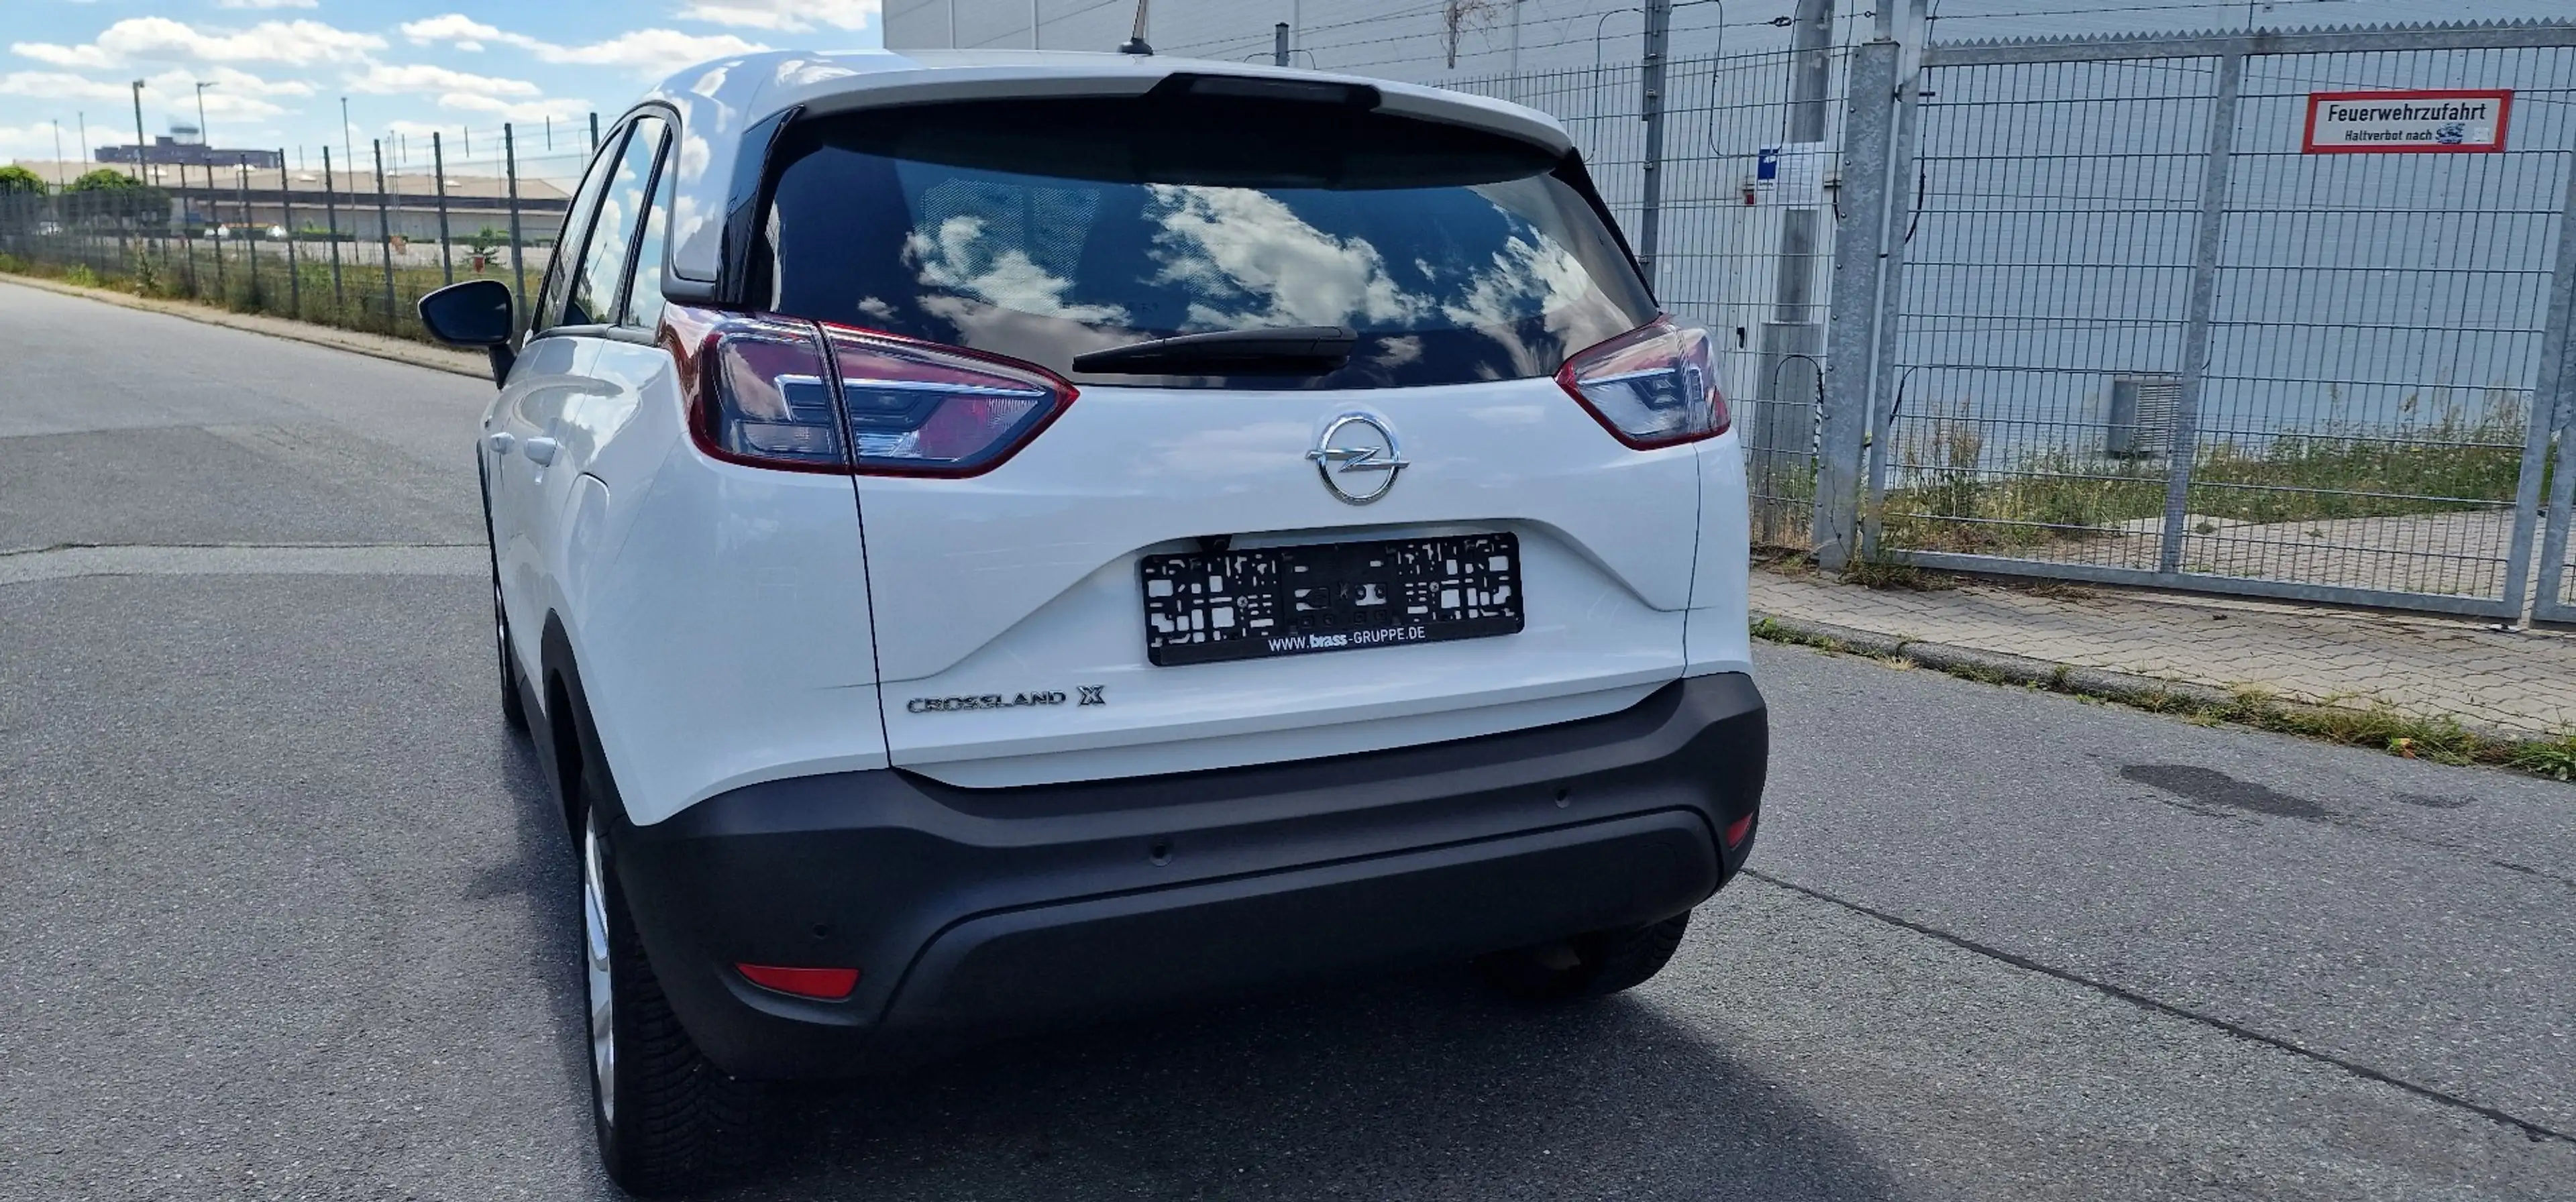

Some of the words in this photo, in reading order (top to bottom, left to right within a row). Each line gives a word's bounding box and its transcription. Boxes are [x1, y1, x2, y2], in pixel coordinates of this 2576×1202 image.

[2328, 103, 2486, 122] Feuerwehrzufahrt
[2345, 129, 2404, 142] Haltverbot
[2406, 129, 2433, 141] nach
[1268, 626, 1426, 652] WWW.brass-GRUPPE.DE
[906, 690, 1067, 713] CROSSLAND
[1076, 684, 1106, 706] X
